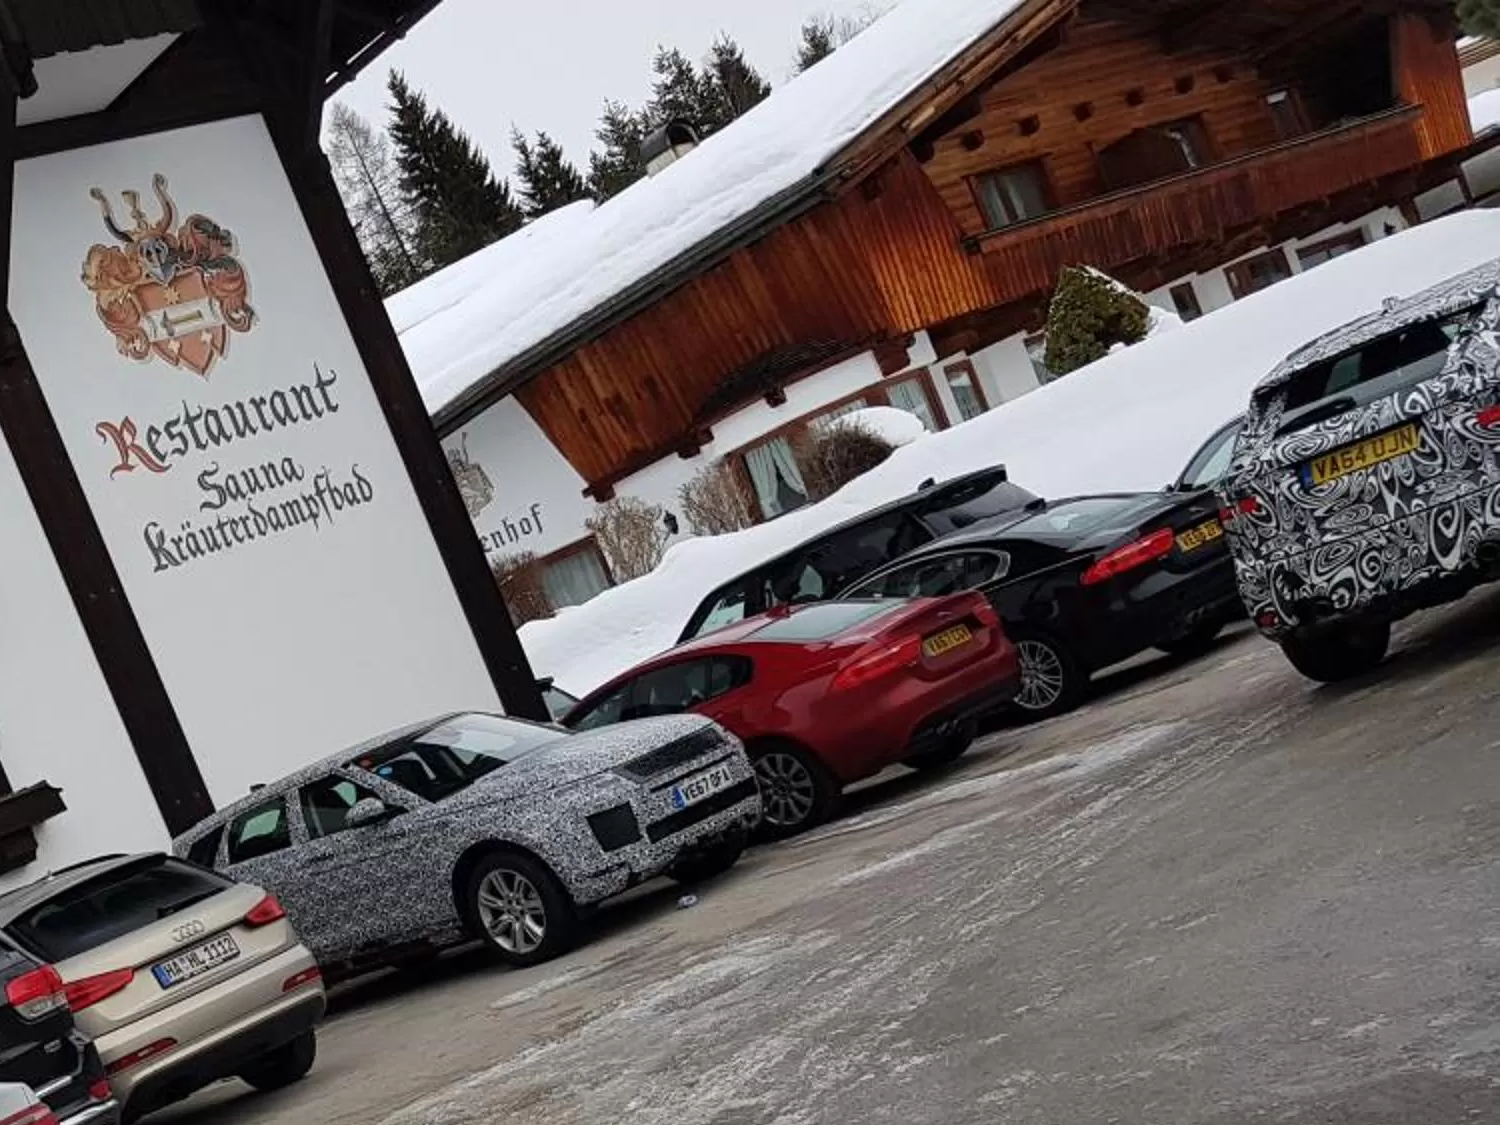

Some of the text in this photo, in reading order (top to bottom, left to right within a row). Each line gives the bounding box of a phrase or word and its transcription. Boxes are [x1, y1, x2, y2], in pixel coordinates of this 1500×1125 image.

[96, 361, 340, 480] Restaurant
[143, 463, 375, 574] Kräuterdampfbad
[197, 451, 305, 512] Sauna
